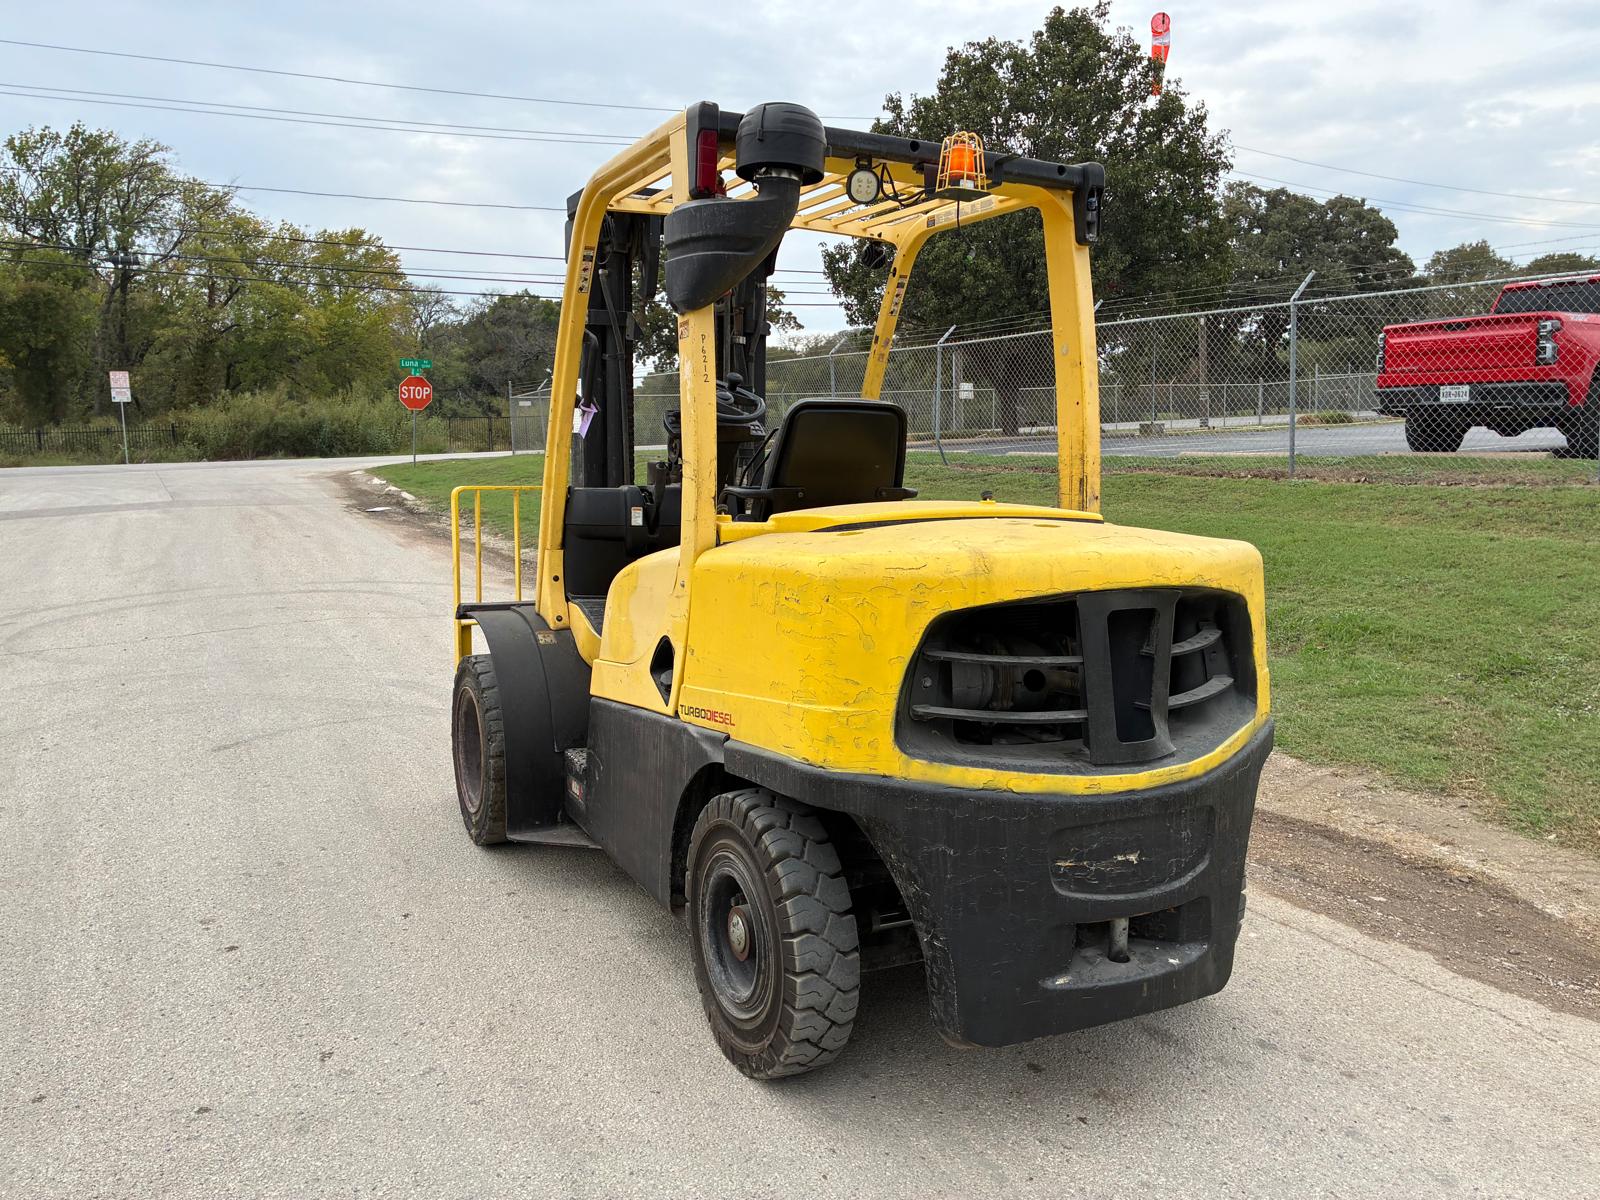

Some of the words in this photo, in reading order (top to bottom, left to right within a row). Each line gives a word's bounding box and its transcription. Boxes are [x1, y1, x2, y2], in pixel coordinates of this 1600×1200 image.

[701, 334, 710, 383] P6212
[401, 386, 431, 399] STOP
[680, 704, 736, 727] TURBODIESEL
